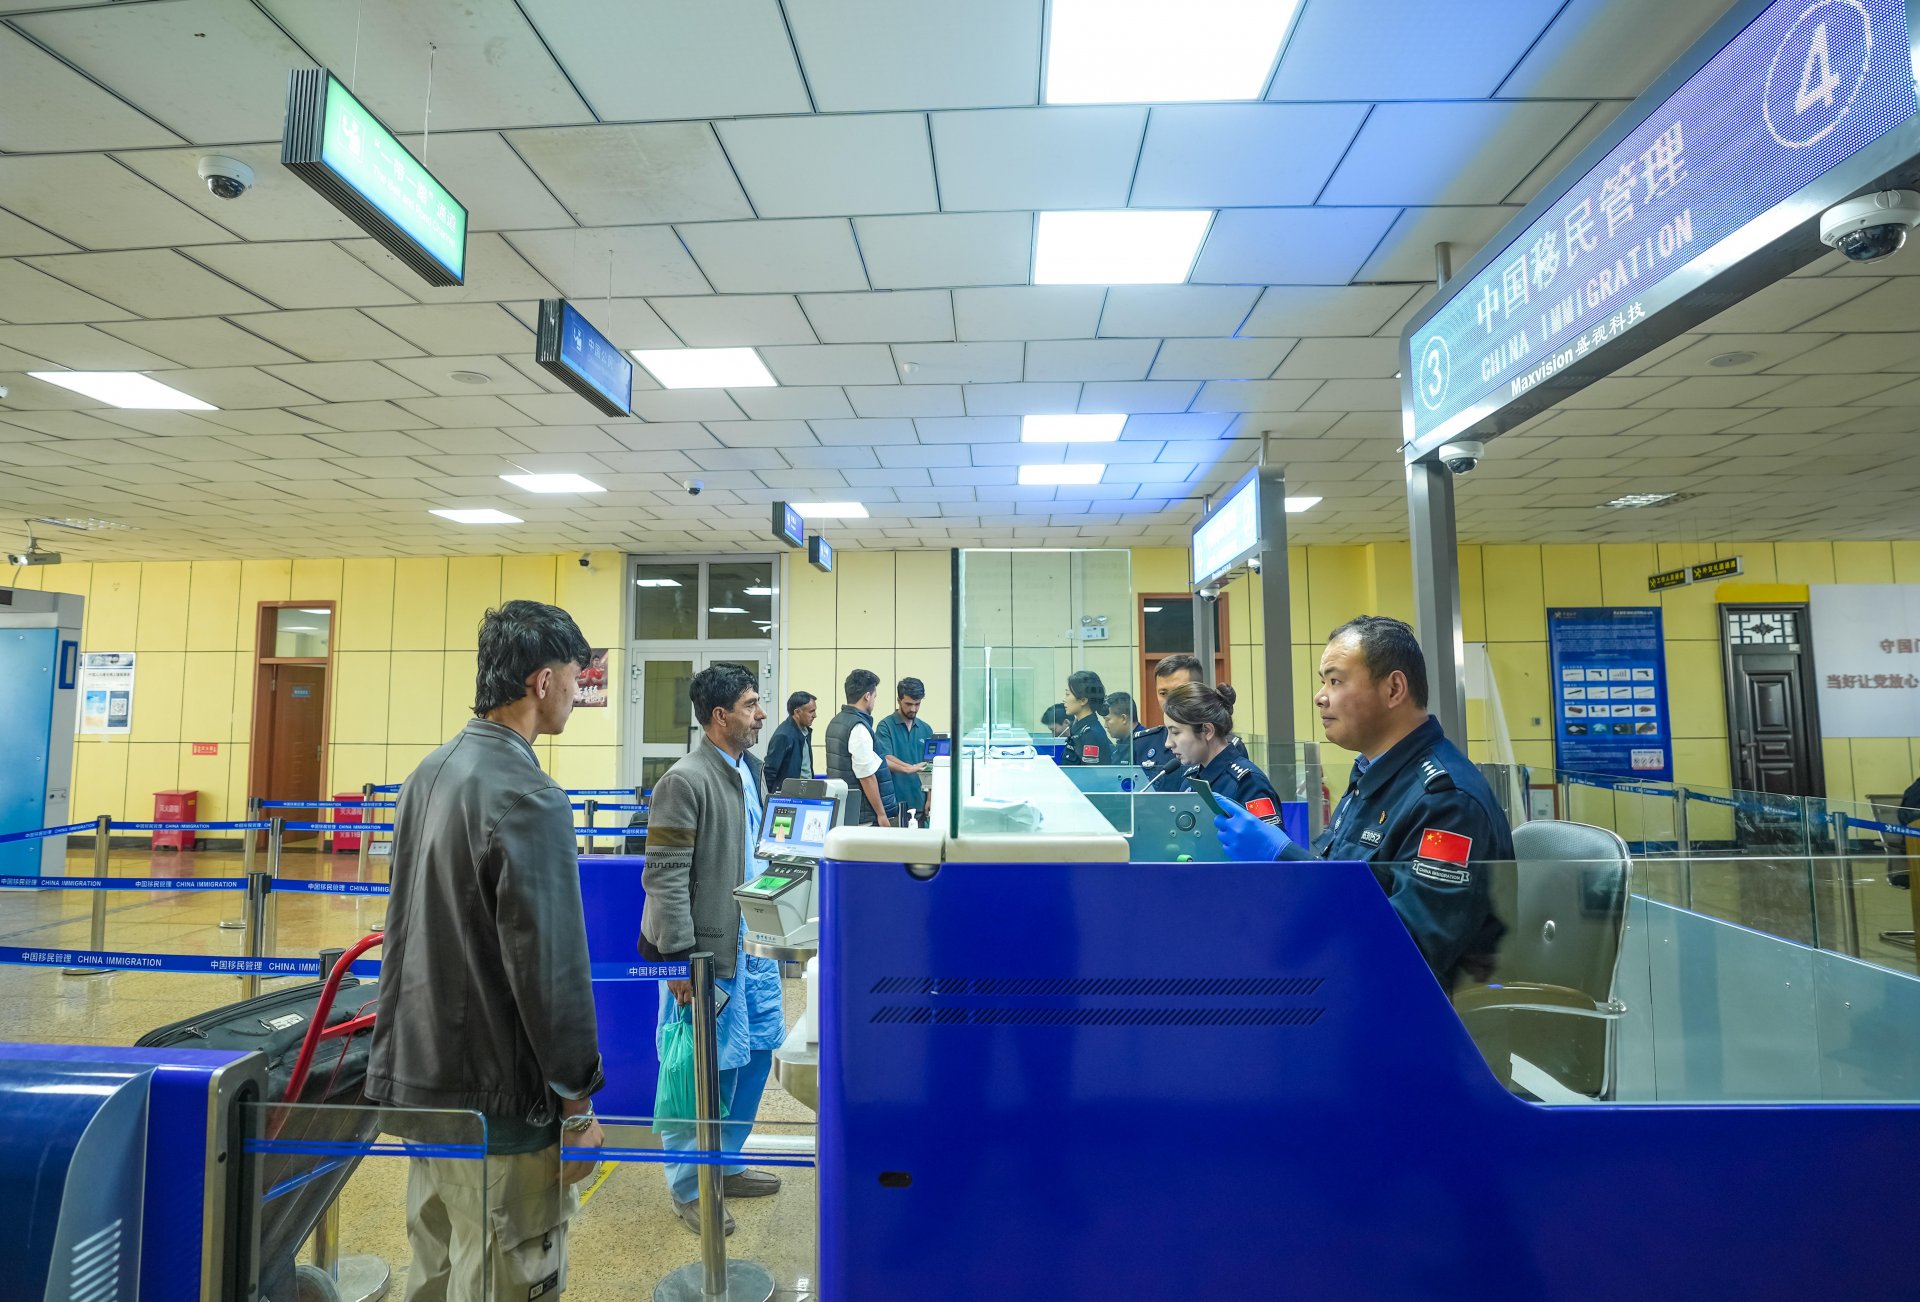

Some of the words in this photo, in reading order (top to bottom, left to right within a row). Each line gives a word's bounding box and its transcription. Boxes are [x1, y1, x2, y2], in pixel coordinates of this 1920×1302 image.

[1795, 21, 1841, 115] 4
[1477, 120, 1689, 334] 中国移民管理
[1481, 331, 1531, 382] CHINA
[1542, 208, 1694, 341] IMMIGRATION
[1427, 350, 1442, 396] 3
[1511, 346, 1574, 398] Maxvision
[1575, 301, 1646, 357] 盛视科技
[22, 951, 72, 963] 中国移民管理
[77, 955, 103, 964] CHINA
[106, 956, 162, 967] IMMIGRATION
[210, 960, 263, 971] 中国移民管理
[268, 962, 295, 971] CHINA
[628, 965, 687, 977] 中国移民管理
